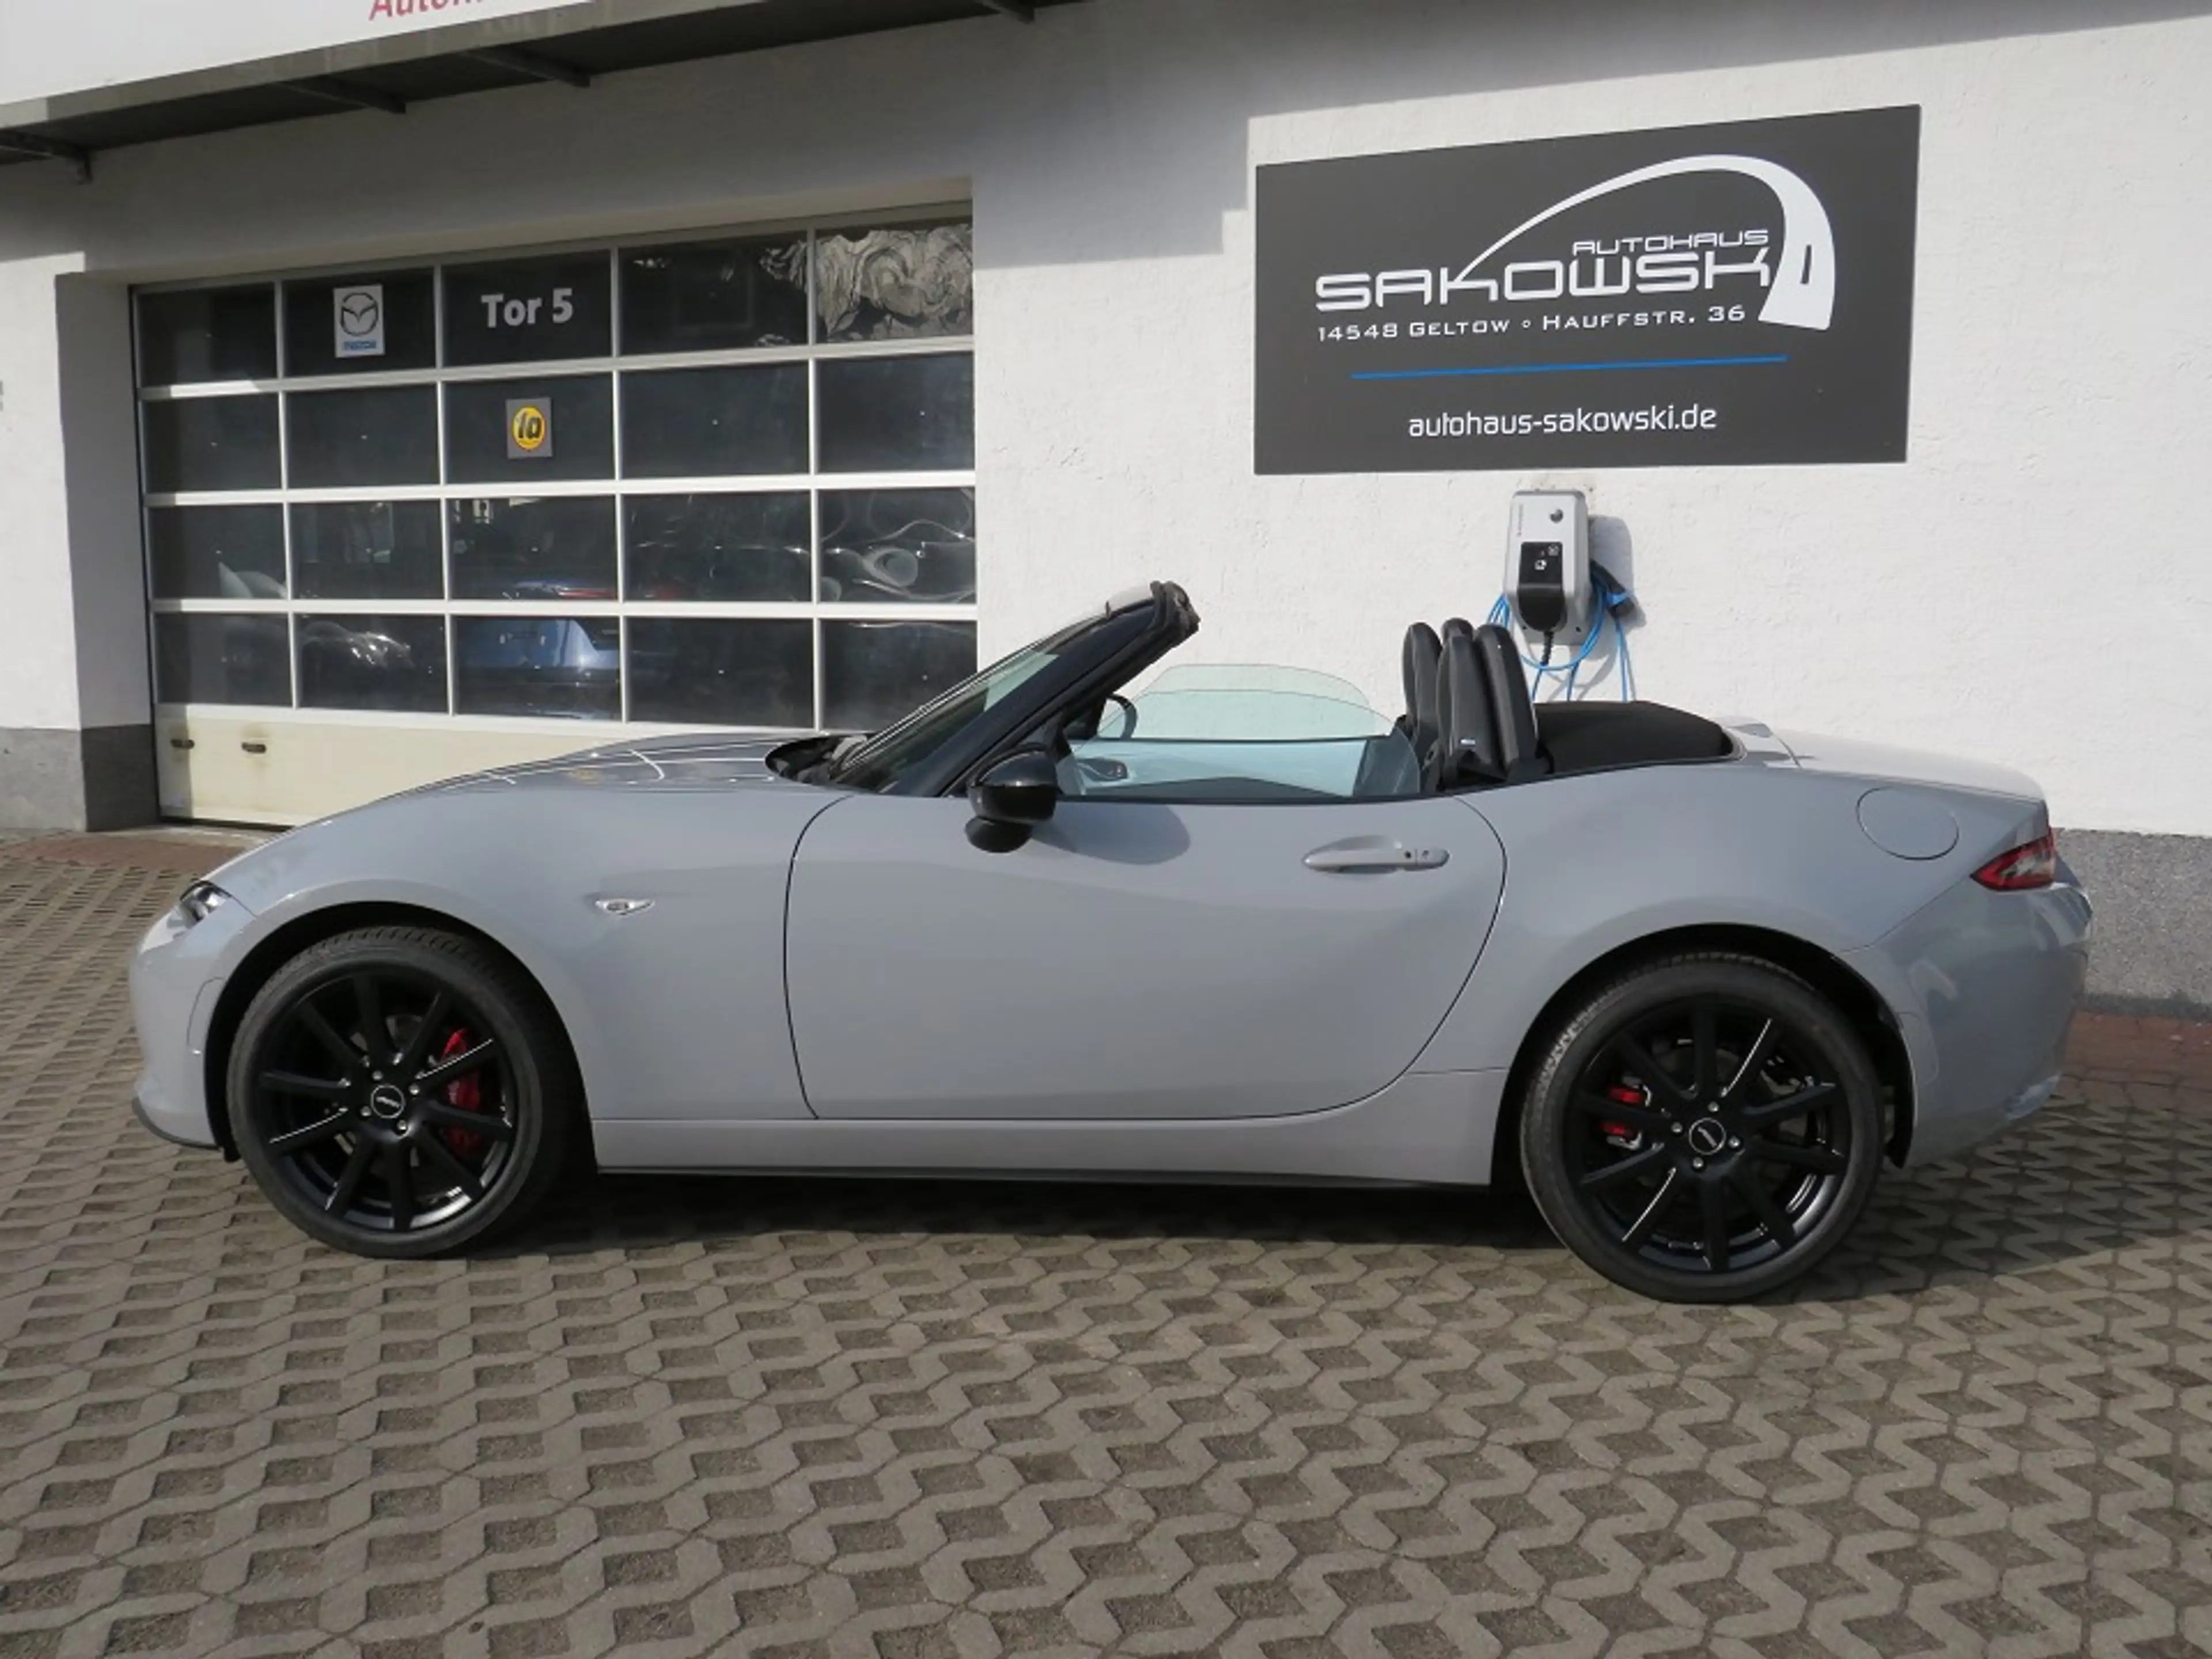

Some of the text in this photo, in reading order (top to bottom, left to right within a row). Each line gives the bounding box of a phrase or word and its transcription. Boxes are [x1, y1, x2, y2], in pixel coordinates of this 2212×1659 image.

[1571, 229, 1769, 256] AUTOHAUS
[481, 287, 574, 328] Tor 5
[1317, 304, 1746, 342] 14548 GELTOW HAUFFSTR. 36
[1408, 403, 1717, 437] autohaus-sakowski.de
